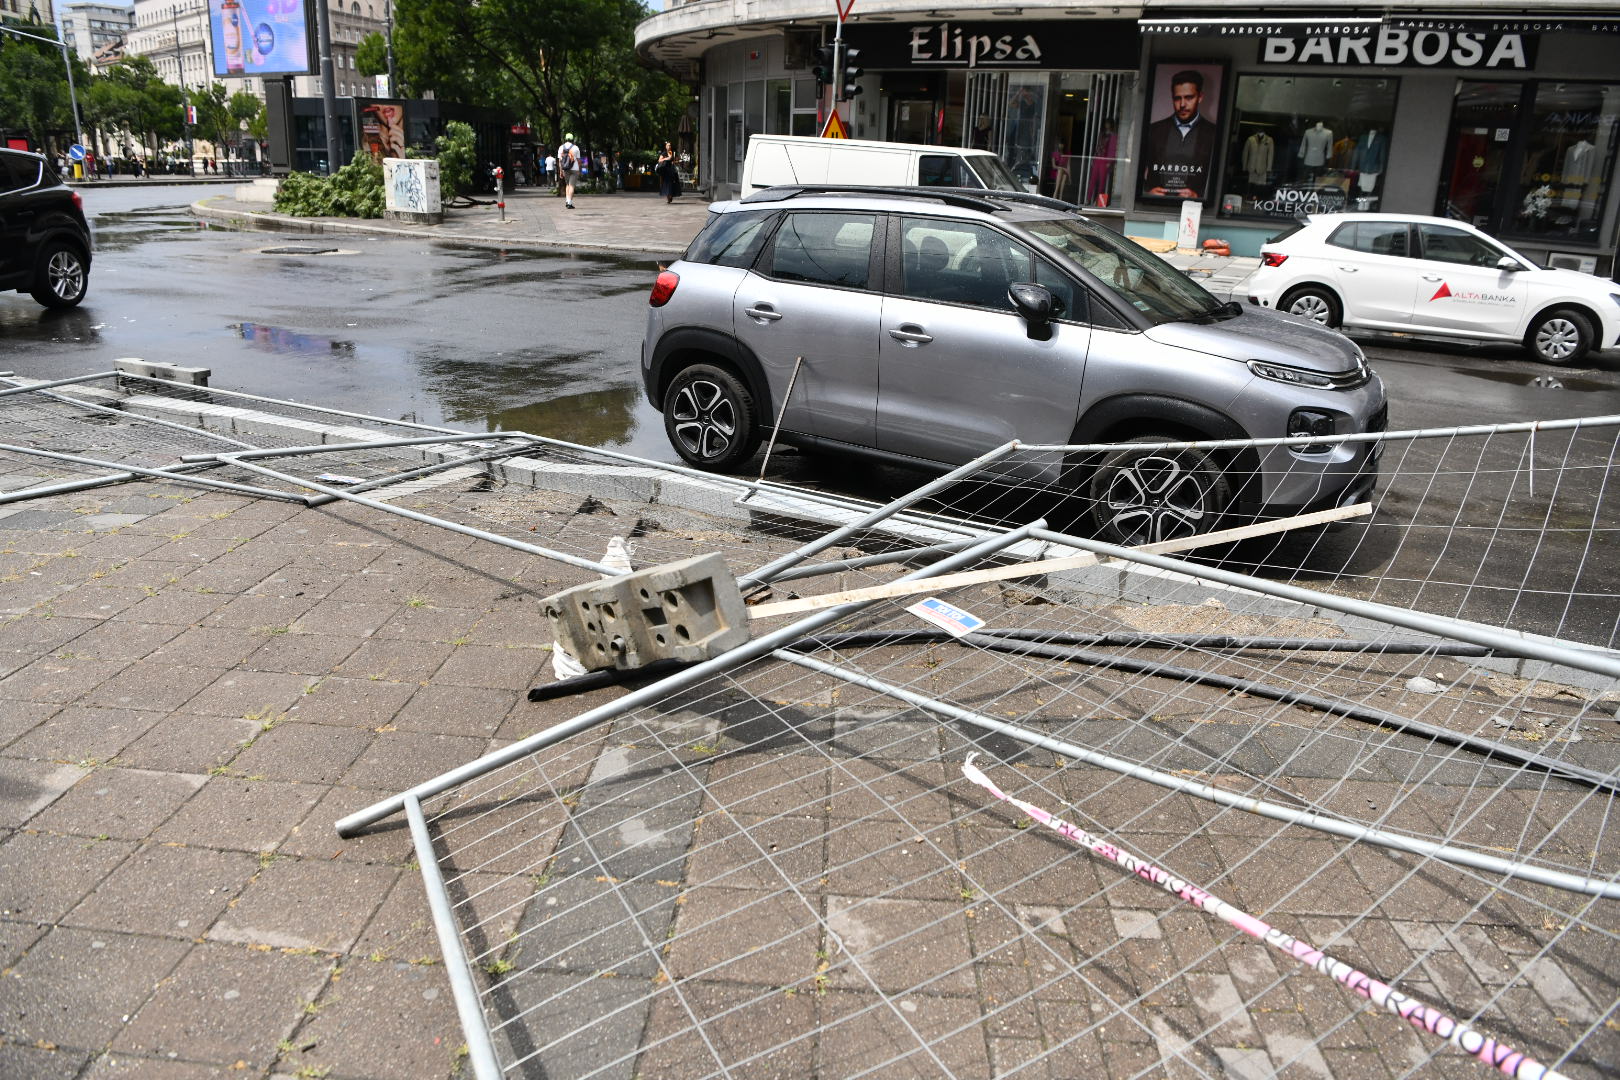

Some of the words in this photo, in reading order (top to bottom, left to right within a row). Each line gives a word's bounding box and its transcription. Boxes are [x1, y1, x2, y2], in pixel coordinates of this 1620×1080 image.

[1140, 26, 1198, 34] BARBOSA
[1221, 26, 1282, 35] BARBOSA
[1306, 26, 1371, 35] BARBOSA
[908, 22, 1042, 68] Elipsa
[1264, 29, 1526, 68] BARBOSA
[1153, 164, 1203, 173] BARBOSA
[1275, 190, 1319, 203] NOVA
[1254, 200, 1337, 215] KOLEKCIJA
